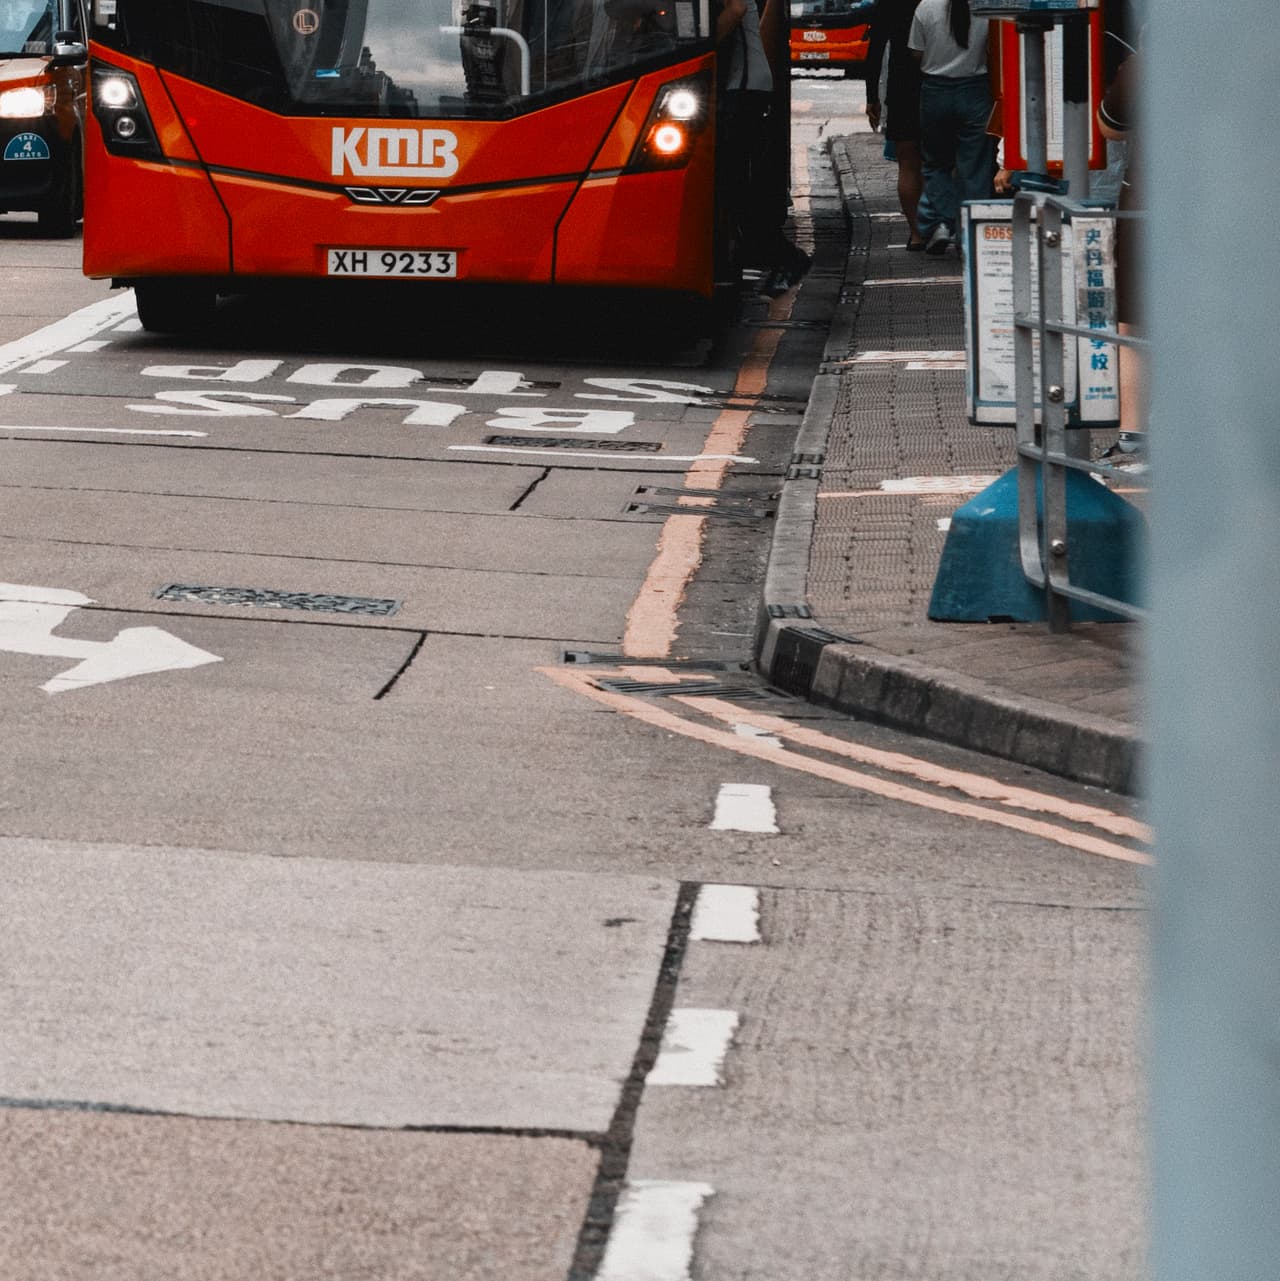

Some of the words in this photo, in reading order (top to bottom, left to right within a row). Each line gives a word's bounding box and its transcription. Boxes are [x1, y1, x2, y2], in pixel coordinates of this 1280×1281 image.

[23, 141, 32, 151] 4
[331, 127, 460, 178] KMB
[333, 251, 368, 272] XH
[380, 252, 452, 274] 9233
[140, 359, 718, 406] STOP
[124, 390, 635, 434] BUS
